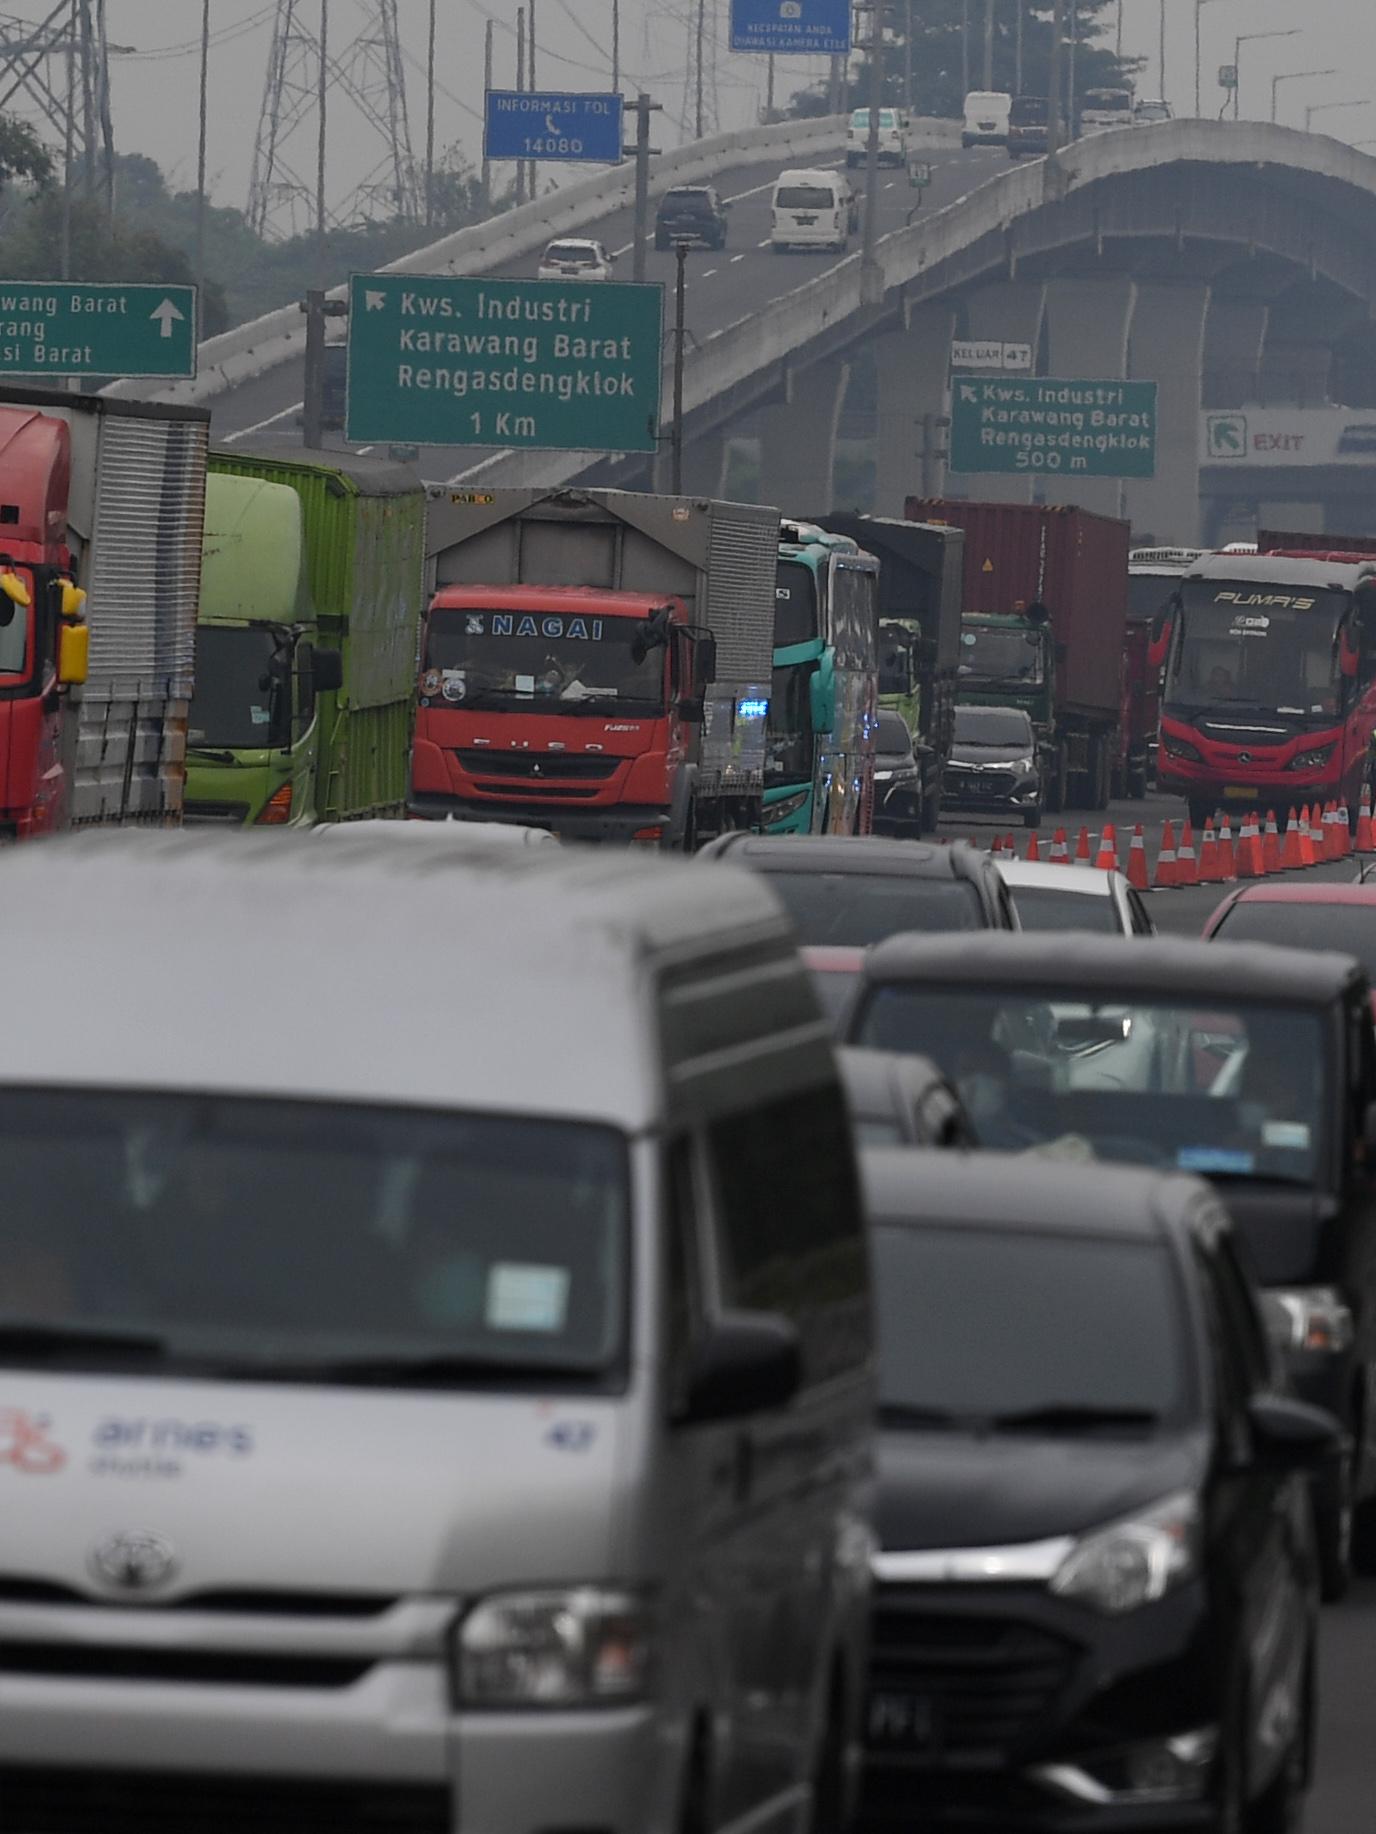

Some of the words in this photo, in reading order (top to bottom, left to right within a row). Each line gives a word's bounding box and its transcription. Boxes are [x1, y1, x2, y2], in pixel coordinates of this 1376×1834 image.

[497, 99, 576, 113] INFORMASI
[584, 101, 611, 115] TOL
[525, 138, 583, 153] 14080
[71, 295, 127, 313] Barat
[401, 292, 462, 318] Kws.
[478, 293, 591, 322] Industri
[34, 345, 92, 363] Barat
[400, 329, 538, 362] Karawang
[554, 334, 631, 360] Barat
[953, 348, 999, 360] KELUAR
[399, 365, 634, 401] Rengasdengklok
[984, 385, 1030, 401] Kws.
[1038, 387, 1123, 405] Industri
[470, 412, 482, 434] 1
[496, 412, 536, 436] Km
[982, 407, 1084, 430] Karawang
[1091, 410, 1149, 428] Barat
[981, 428, 1149, 452] Rengasdengklok
[1254, 433, 1304, 451] EXIT
[1016, 451, 1061, 468] 500
[1070, 456, 1088, 468] m
[1213, 592, 1315, 610] PUMA'S
[492, 615, 603, 641] NAGAI
